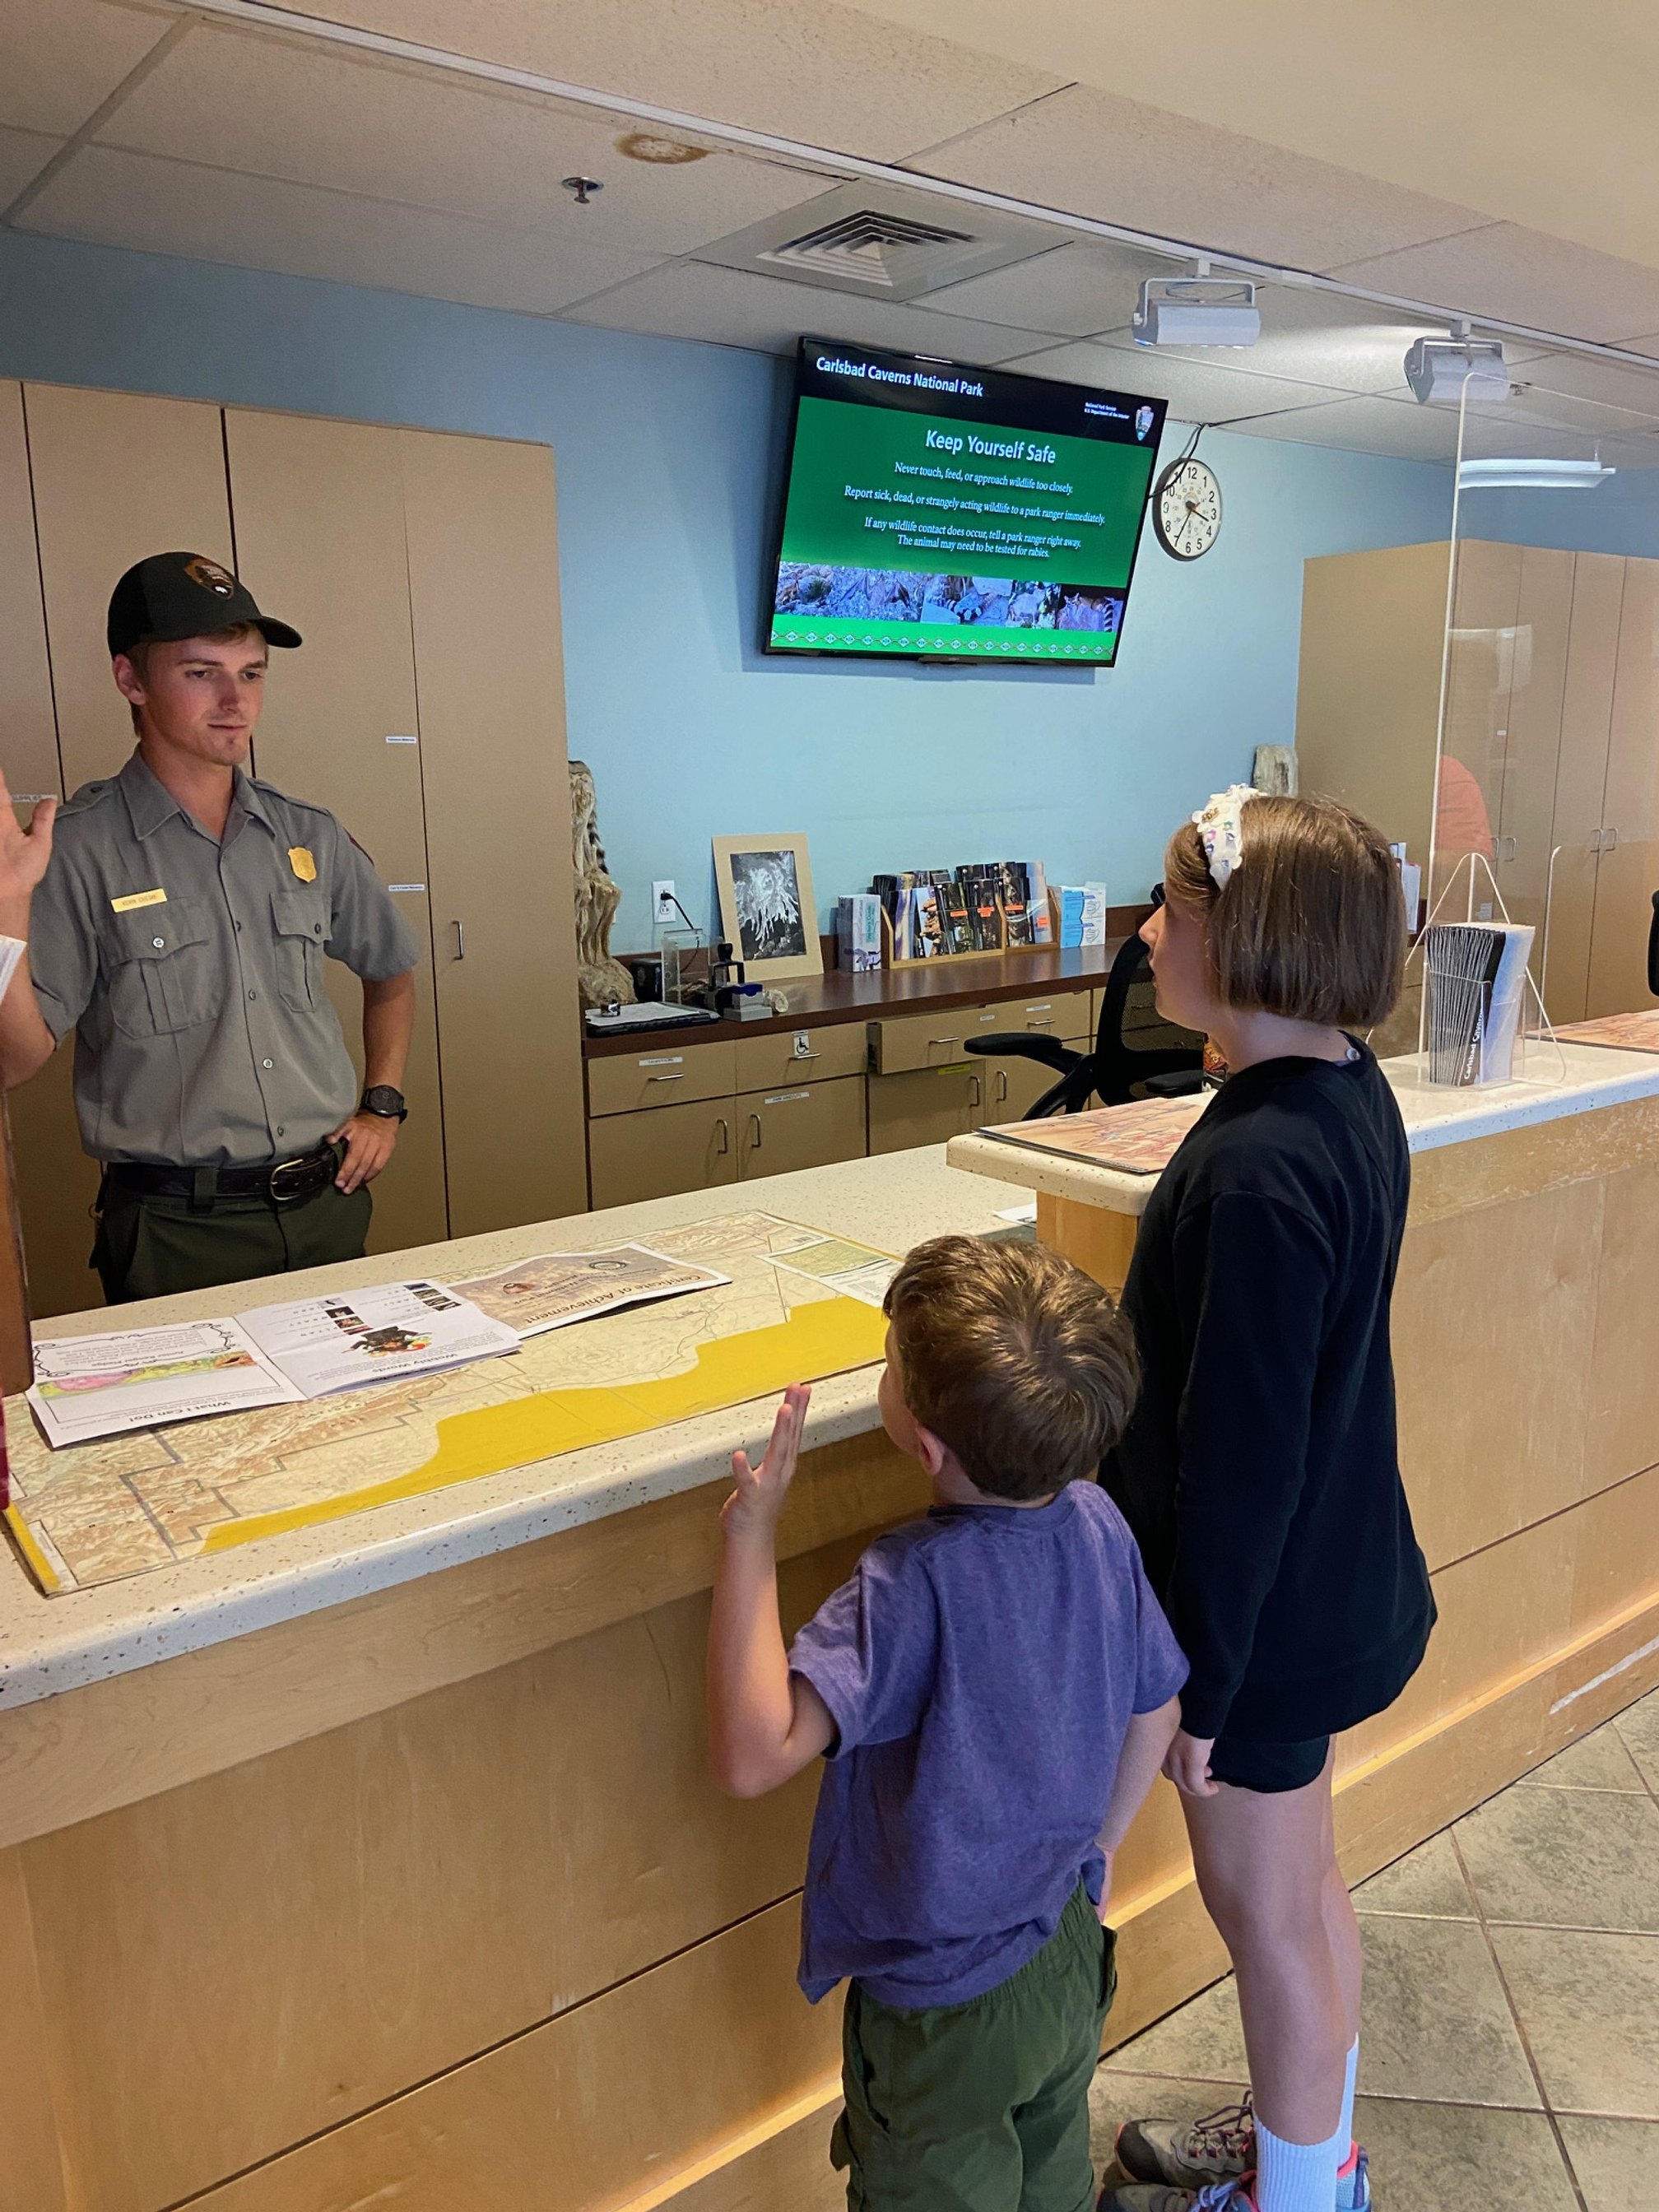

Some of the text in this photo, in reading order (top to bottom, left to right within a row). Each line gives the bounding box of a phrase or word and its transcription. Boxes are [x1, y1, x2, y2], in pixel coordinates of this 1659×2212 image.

[816, 357, 983, 397] Carlsbad Caverns National Park
[926, 430, 1056, 463] Keep Yourself Safe
[895, 462, 1073, 495] Never touch, feed, or approach wildlife too closely.
[1187, 467, 1197, 479] 12
[1165, 486, 1175, 497] 10
[1209, 490, 1215, 503] 2
[844, 486, 872, 500] Report
[874, 489, 892, 502] sick,
[894, 491, 914, 505] dead,
[925, 496, 960, 510] strangely
[960, 500, 983, 514] acting
[984, 502, 1011, 514] wildlife
[1011, 505, 1019, 514] to
[1025, 507, 1040, 518] park
[1042, 510, 1065, 522] ranger
[1065, 510, 1105, 526] immediately.
[1164, 502, 1169, 514] 9
[1211, 509, 1216, 520] 3
[1165, 520, 1171, 532] 8
[1206, 525, 1211, 537] 4
[864, 517, 872, 527] If
[872, 519, 887, 532] any
[889, 520, 917, 532] wildlife
[918, 523, 946, 535] contact
[947, 525, 964, 537] does
[966, 530, 988, 541] occur,
[989, 530, 1001, 540] tell
[1006, 532, 1022, 543] park
[1024, 535, 1046, 546] ranger
[1047, 536, 1062, 547] right
[1063, 539, 1081, 550] away.
[897, 535, 1050, 558] The animal may need to be tested for rabies.
[1186, 542, 1191, 553] 6
[1197, 538, 1202, 550] 5
[1464, 1043, 1476, 1080] Carlsbad
[525, 1276, 701, 1323] Certificate of Achievement
[196, 1401, 230, 1410] What
[129, 1414, 154, 1422] Do!
